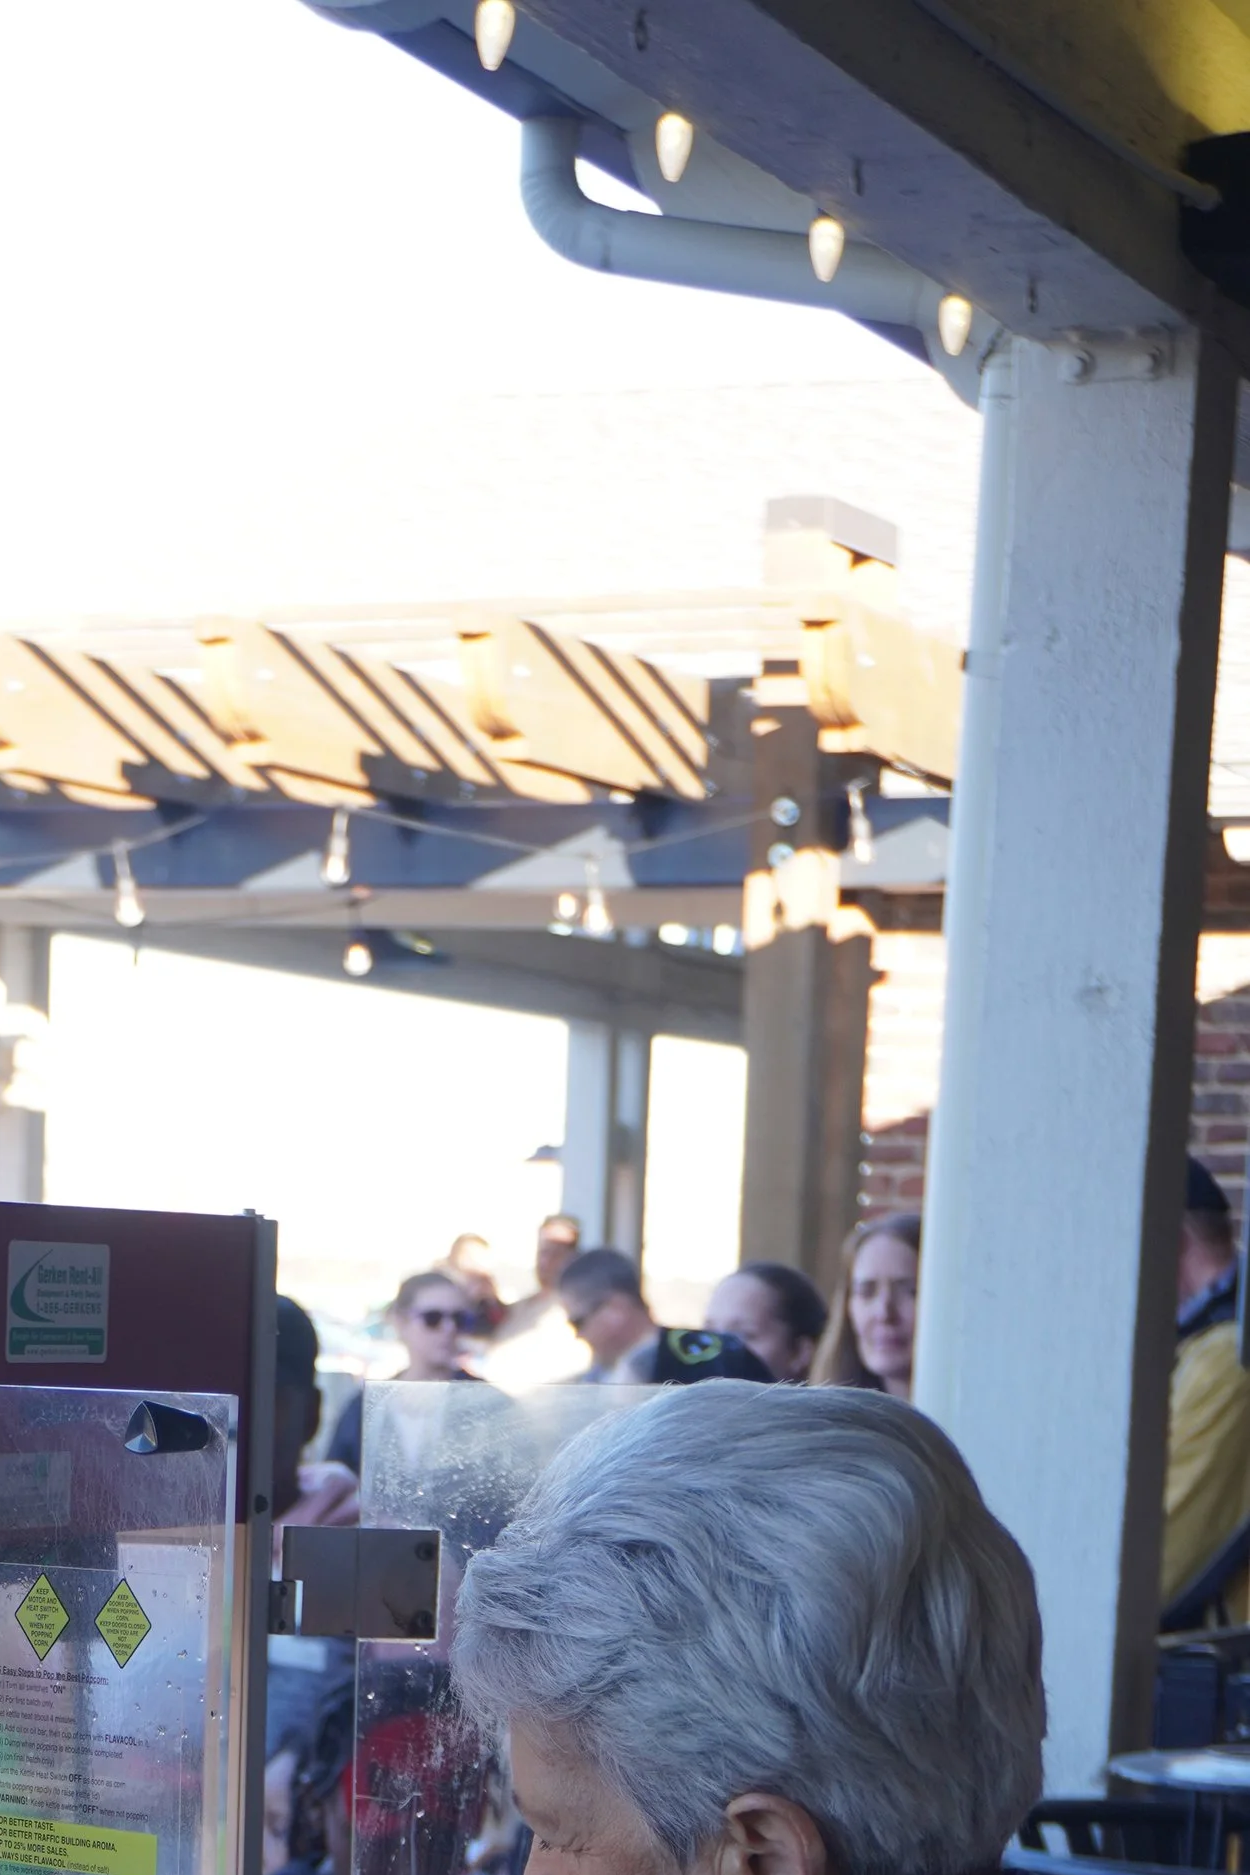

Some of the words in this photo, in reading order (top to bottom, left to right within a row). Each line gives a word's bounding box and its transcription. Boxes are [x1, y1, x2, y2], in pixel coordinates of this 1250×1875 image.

[38, 1264, 67, 1284] Gerken
[31, 1630, 53, 1638] POPPING
[3, 1666, 16, 1677] Easy
[18, 1668, 34, 1679] Steps
[67, 1672, 81, 1683] Best
[50, 1684, 66, 1696] "ON"
[105, 1734, 137, 1747] FLAVACOL
[69, 1773, 82, 1784] OFF
[79, 1803, 99, 1816] "OFF"
[9, 1817, 33, 1829] BETTER
[4, 1840, 13, 1849] TO
[14, 1841, 26, 1851] 25%
[27, 1843, 45, 1854] MORE
[9, 1828, 33, 1841] BETTER
[34, 1832, 59, 1845] TRAFFIC
[62, 1835, 91, 1849] BUILDING
[92, 1839, 118, 1853] AROMA,
[20, 1854, 32, 1864] USE
[34, 1855, 66, 1869] FLAVACOL
[68, 1860, 90, 1873] (instead
[98, 1864, 110, 1875] salt)
